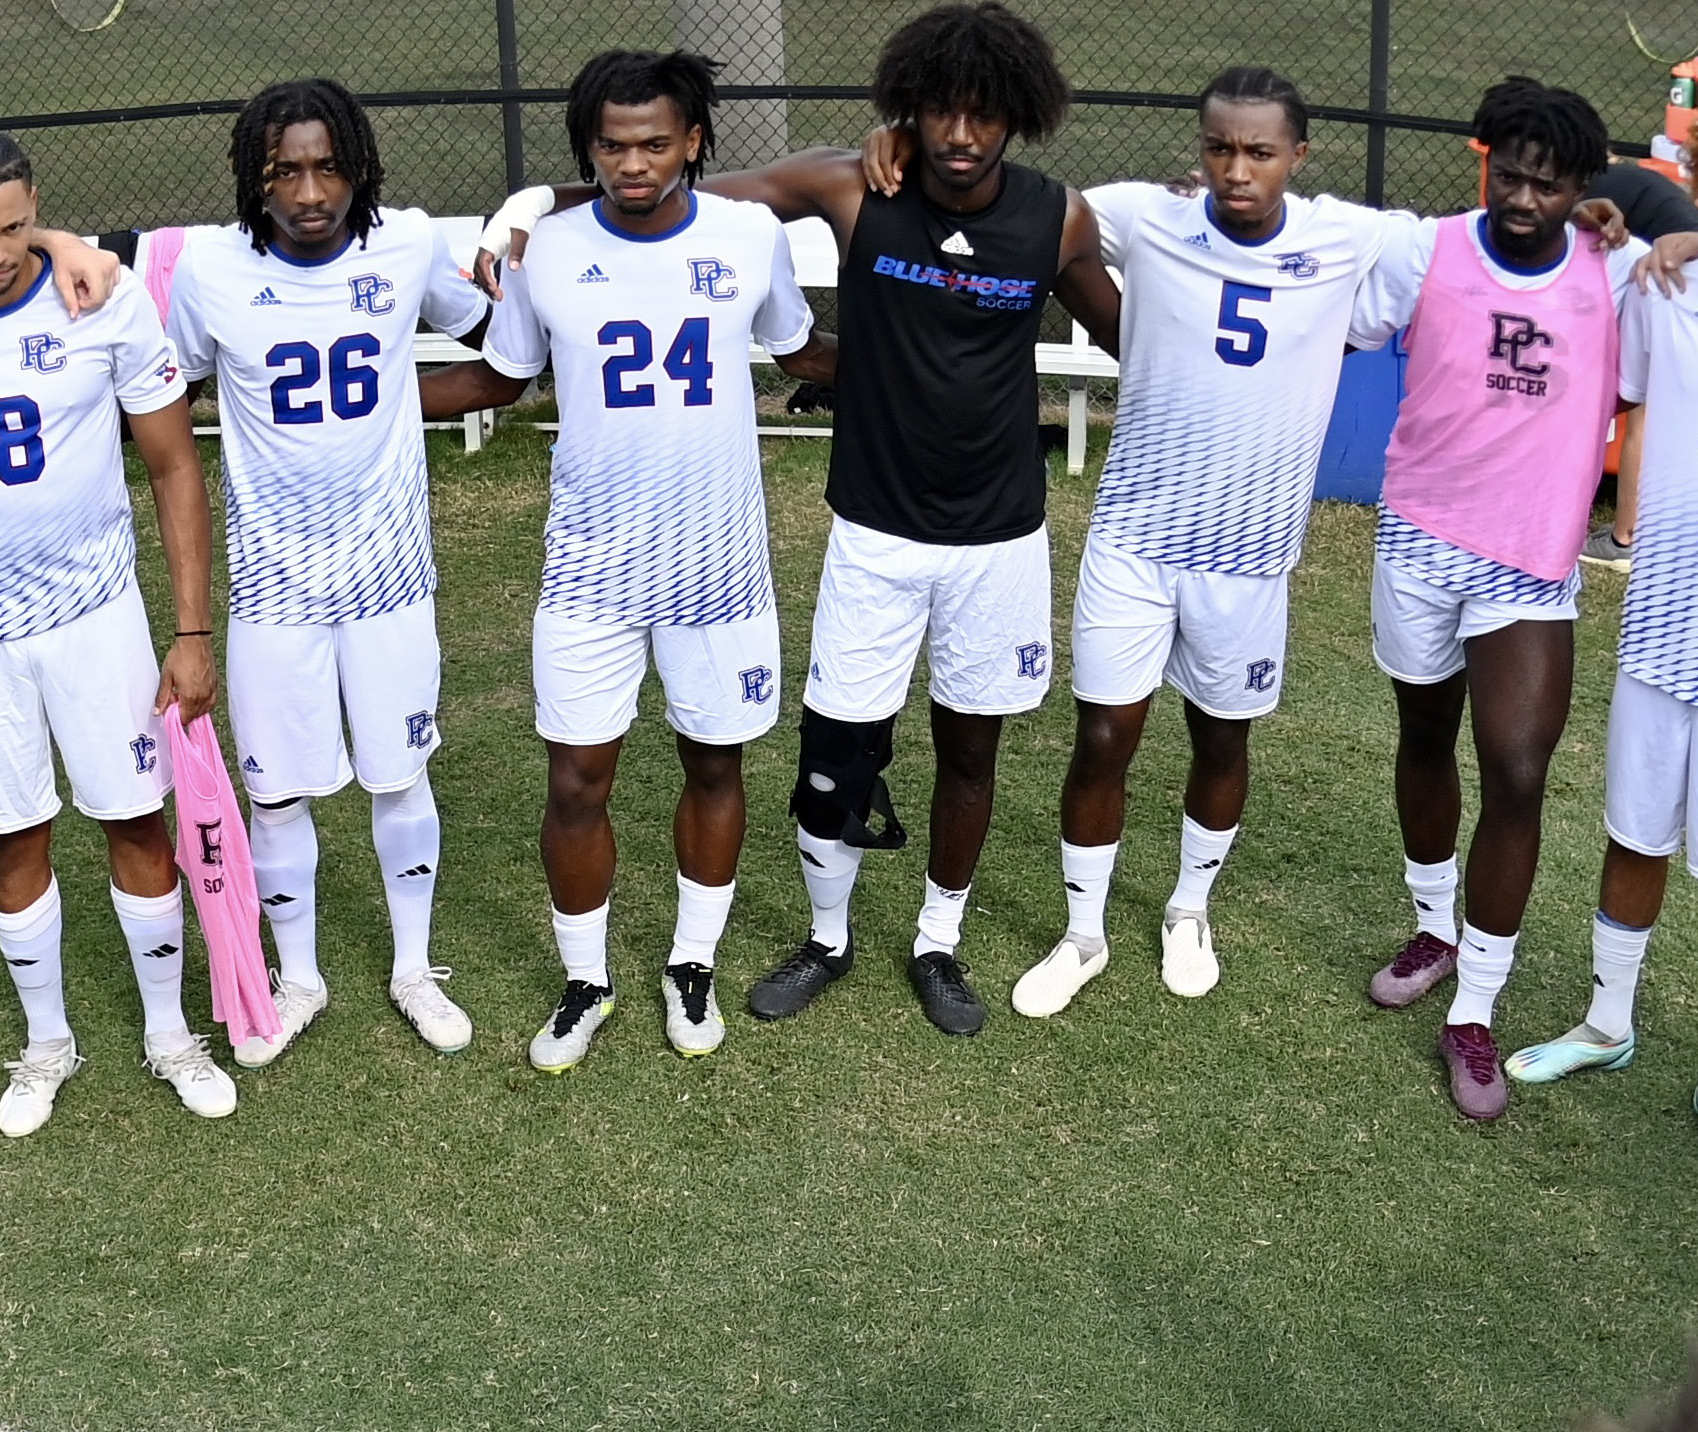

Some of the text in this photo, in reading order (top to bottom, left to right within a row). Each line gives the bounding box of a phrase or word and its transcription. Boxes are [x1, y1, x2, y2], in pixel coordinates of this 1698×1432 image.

[348, 272, 396, 317] PC
[686, 257, 738, 302] PC
[873, 255, 1037, 298] BLUE HOSE
[975, 296, 1032, 311] SOCCER
[1214, 280, 1272, 367] 5
[20, 331, 68, 376] PC
[597, 316, 714, 410] 24
[1487, 310, 1553, 378] PC
[265, 332, 381, 425] 26
[1485, 373, 1547, 397] SOCCER
